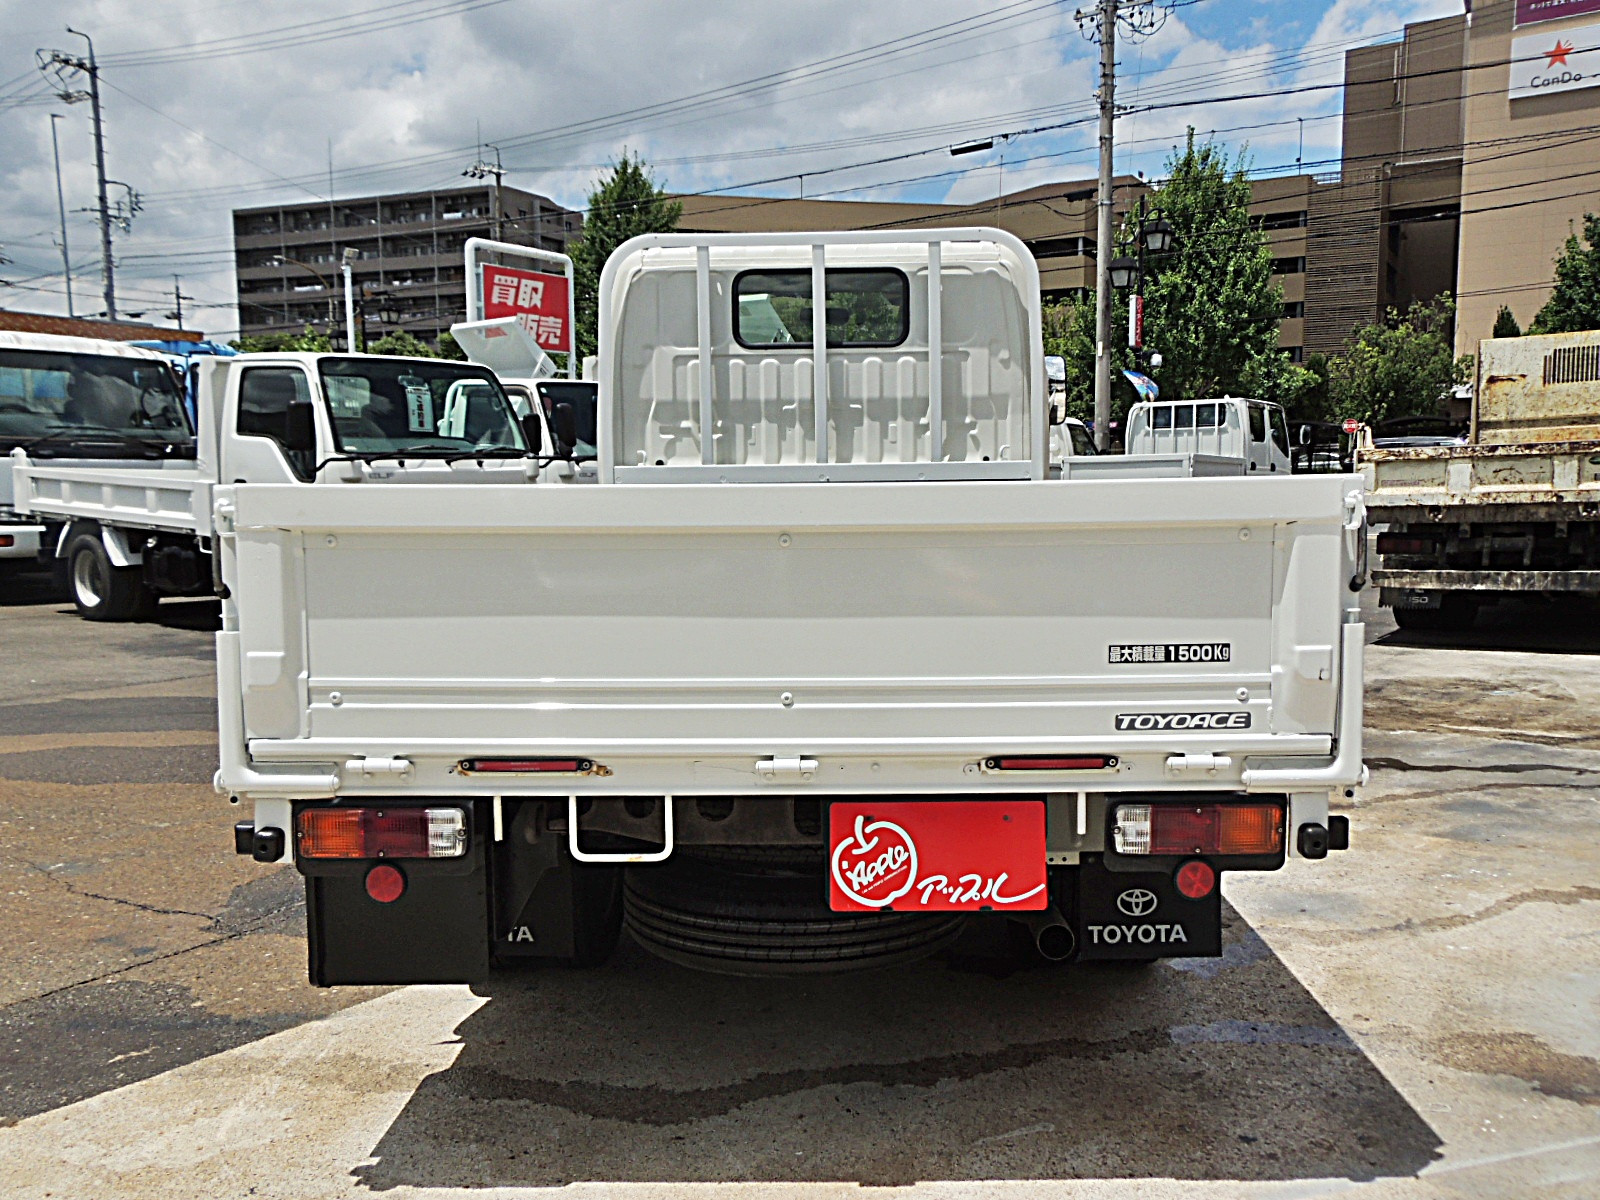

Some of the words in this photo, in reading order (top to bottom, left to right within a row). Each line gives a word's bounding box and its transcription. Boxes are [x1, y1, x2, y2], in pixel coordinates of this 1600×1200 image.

[1531, 72, 1582, 88] CanDo
[491, 274, 545, 309] 買取
[516, 312, 562, 345] 販売
[1109, 646, 1165, 662] 最大積載量
[1118, 713, 1248, 729] TOYOACE
[917, 872, 1046, 904] アップル
[1088, 924, 1188, 944] TOYOTA
